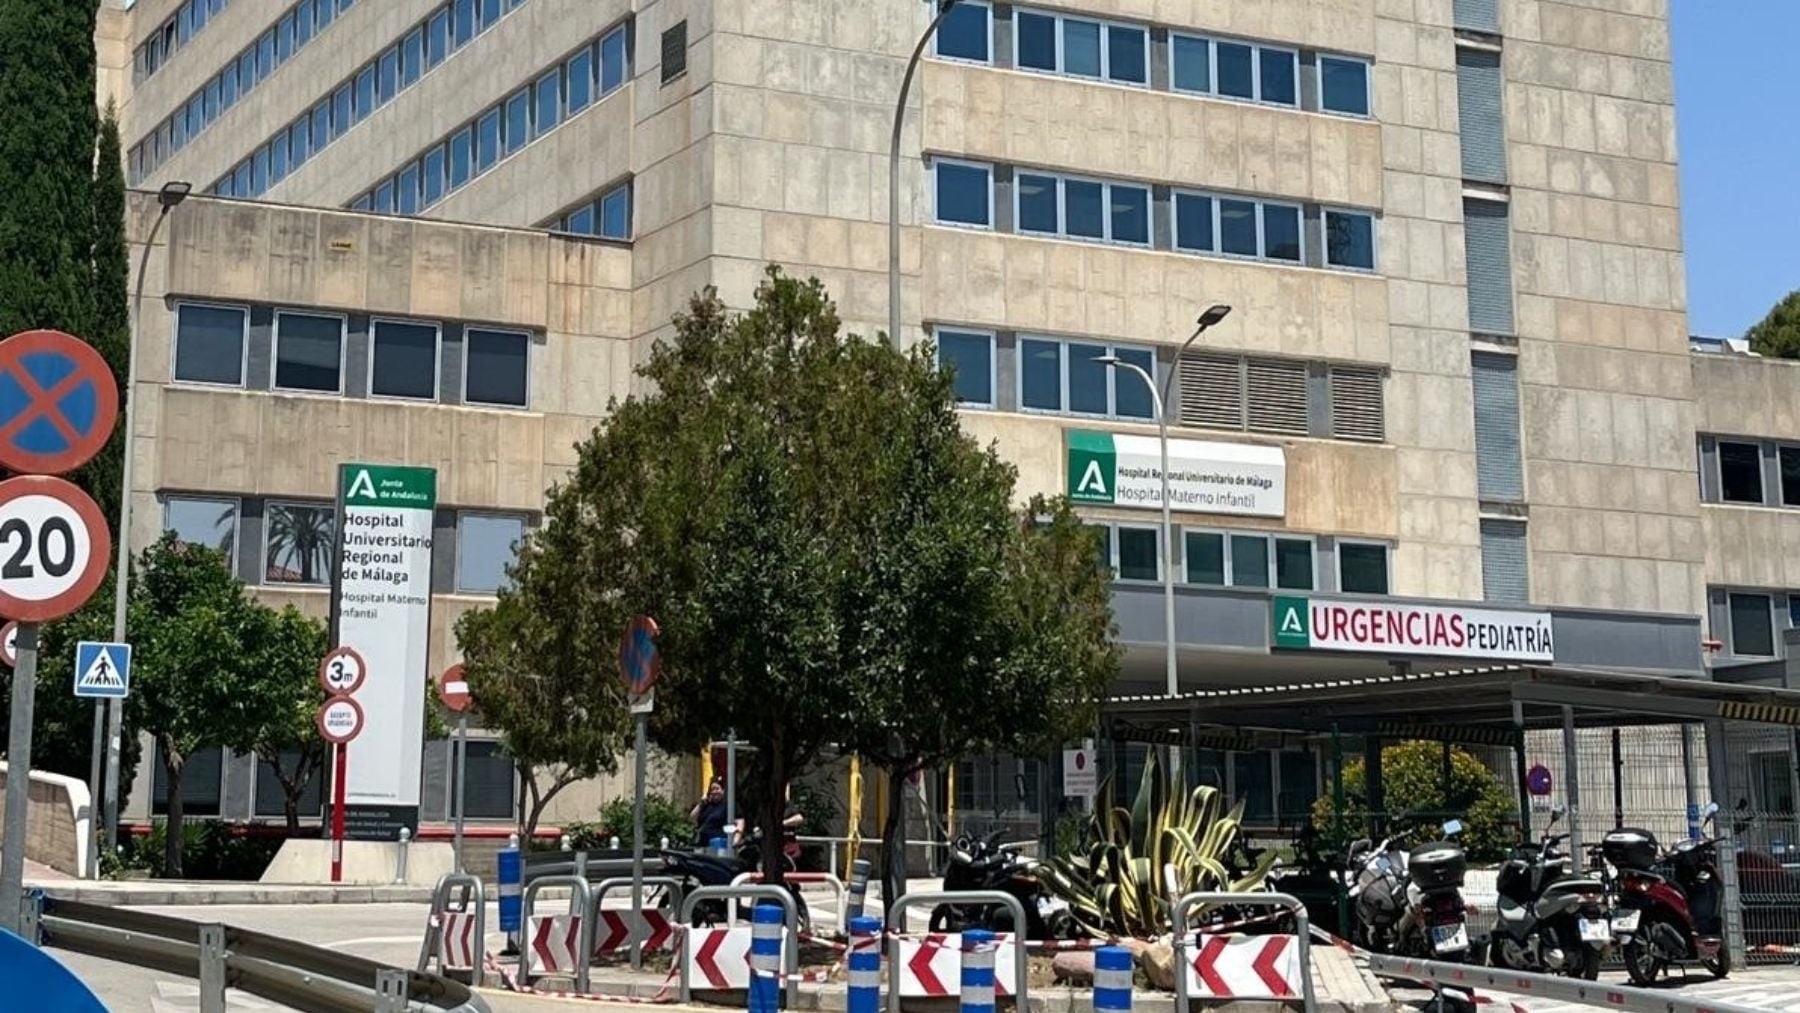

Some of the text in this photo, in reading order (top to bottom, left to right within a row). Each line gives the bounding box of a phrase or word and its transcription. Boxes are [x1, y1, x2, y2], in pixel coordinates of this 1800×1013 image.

[1118, 466, 1150, 479] Hospital
[1151, 468, 1185, 482] Reonal
[1186, 472, 1234, 485] Universitario
[1235, 475, 1245, 485] de
[380, 491, 389, 499] de
[1167, 488, 1214, 504] Materno
[1215, 491, 1256, 508] Infantil
[344, 512, 404, 529] Hospital
[0, 516, 75, 580] 20
[342, 531, 432, 549] Universitario
[342, 550, 403, 566] Regional
[342, 567, 408, 585] de Málaga
[387, 593, 426, 606] Materno
[1312, 606, 1552, 654] URGENCIAS PEDIATRÍA
